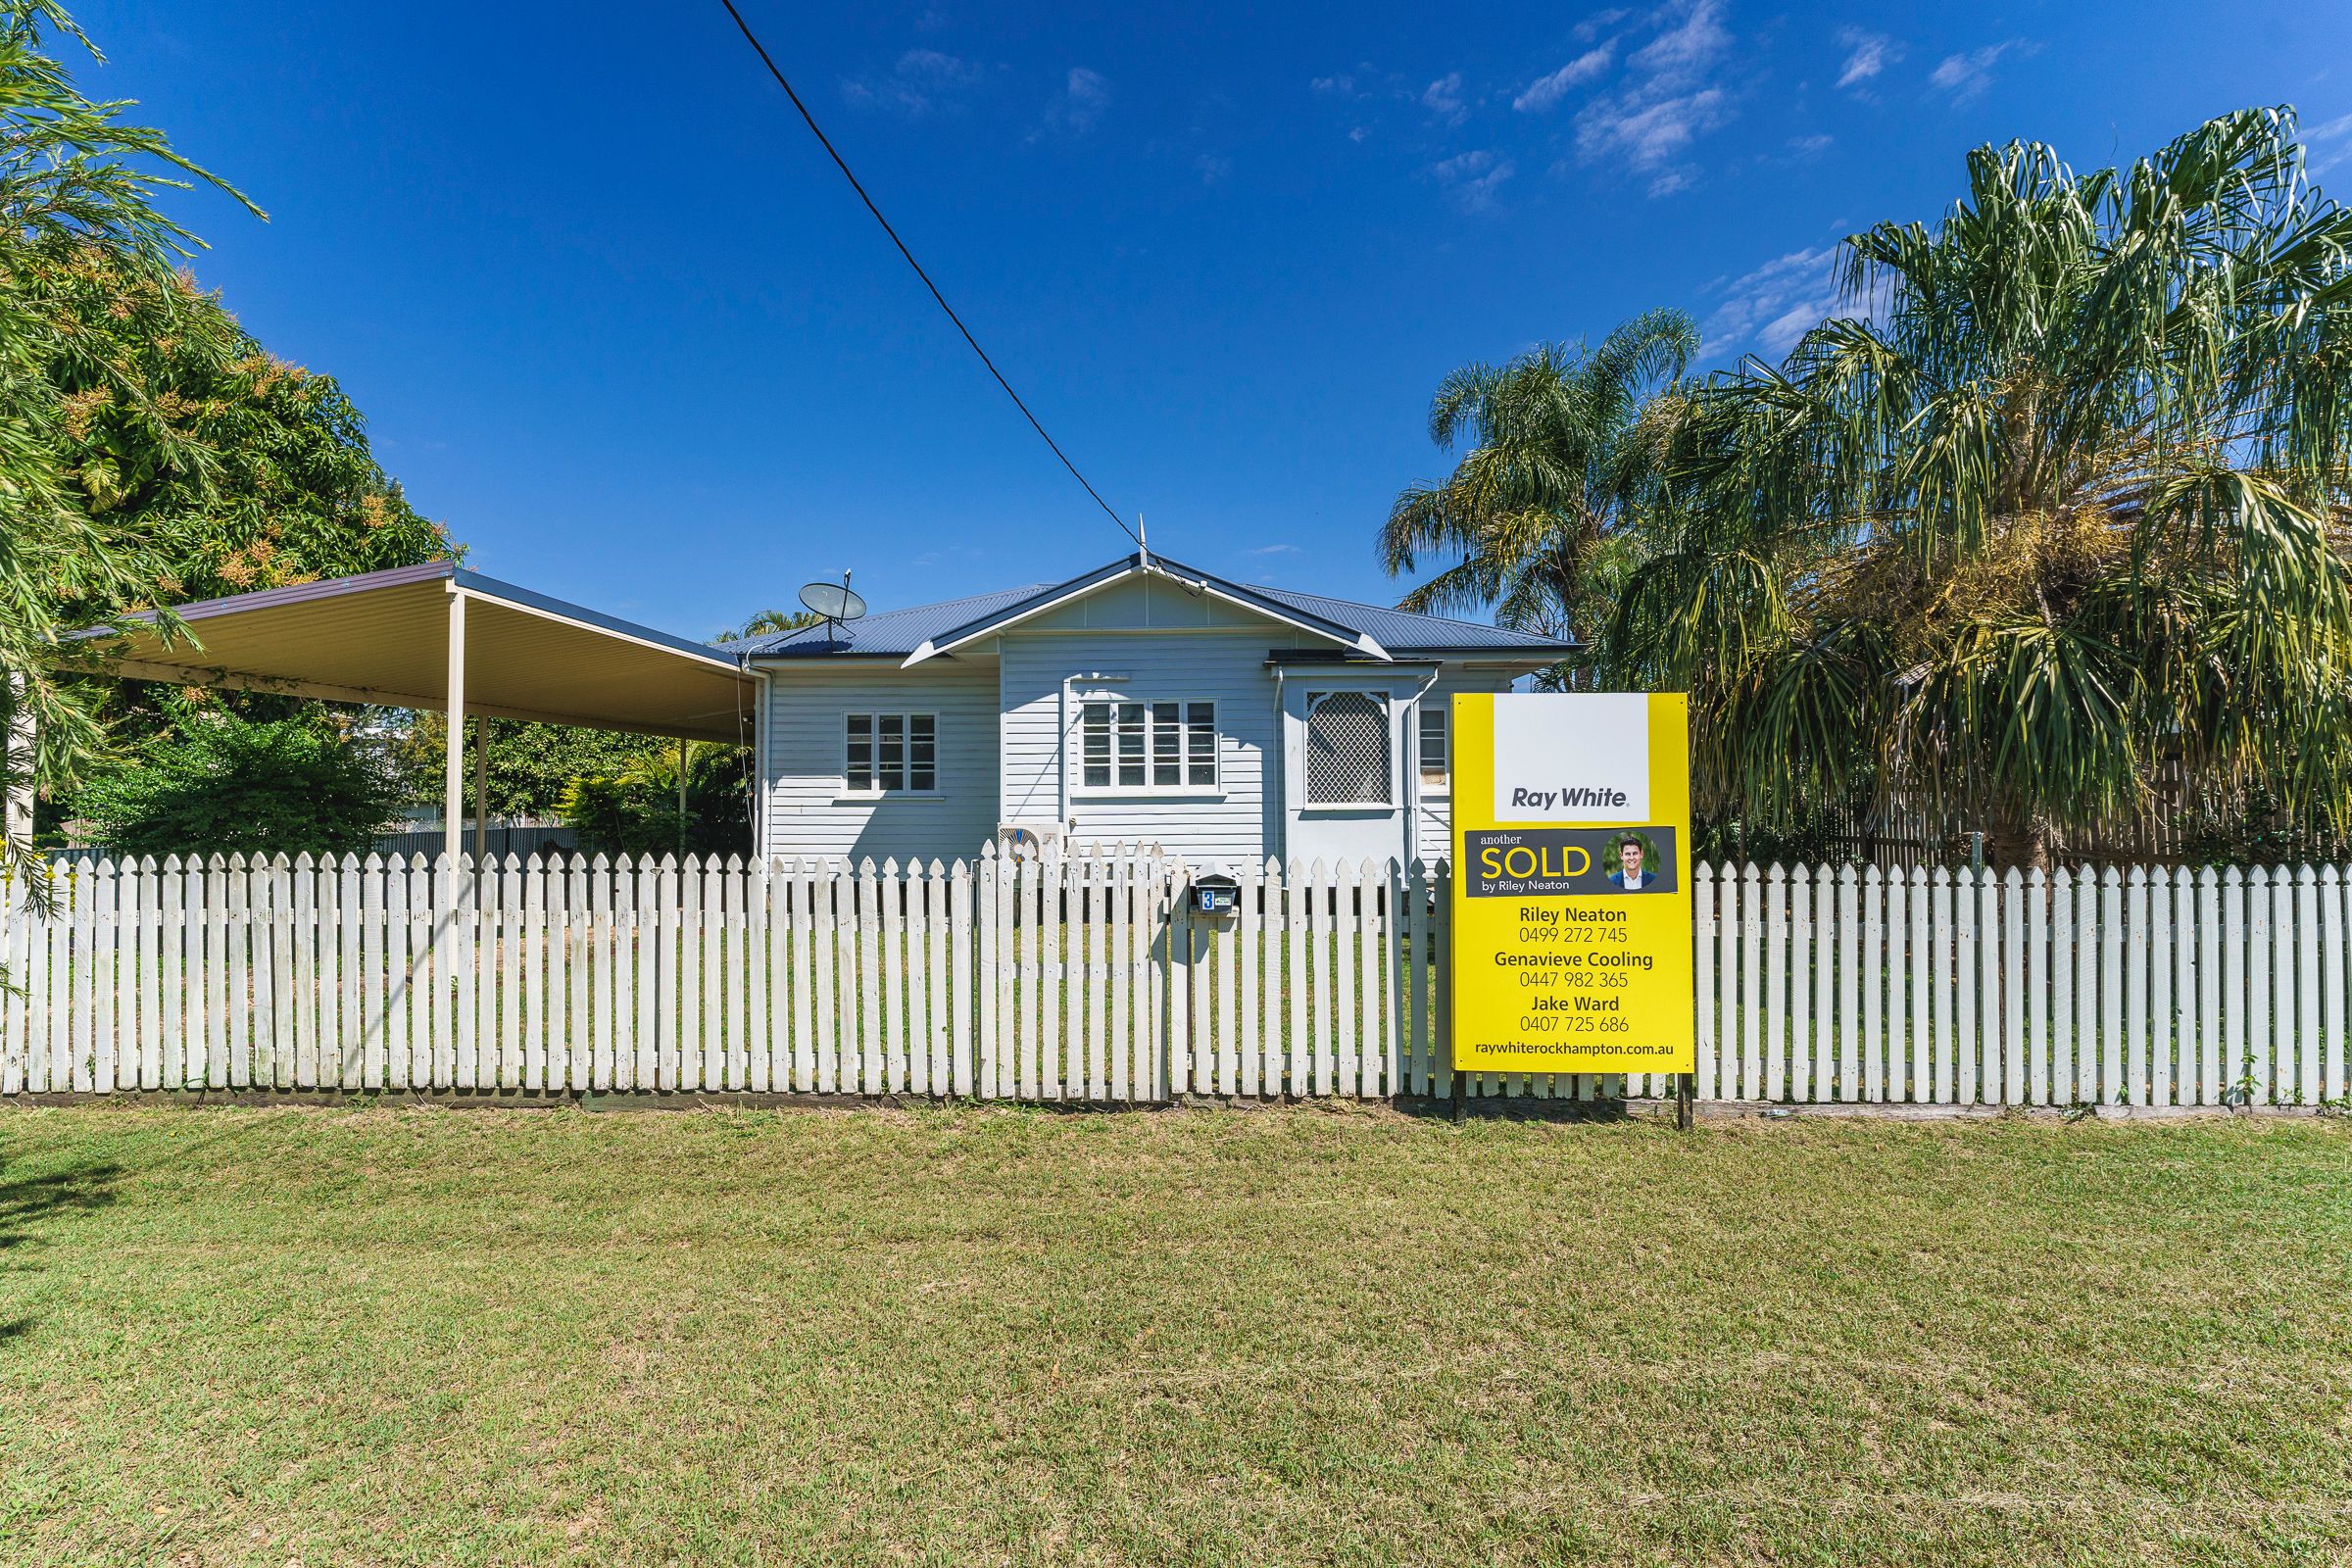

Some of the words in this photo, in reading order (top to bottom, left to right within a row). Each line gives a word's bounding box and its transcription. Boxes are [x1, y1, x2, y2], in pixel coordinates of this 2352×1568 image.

[1512, 788, 1557, 810] Ray
[1562, 788, 1626, 807] White
[1481, 834, 1522, 845] another
[1481, 846, 1592, 879] SOLD
[1482, 880, 1495, 892] by
[1498, 880, 1526, 893] Riley
[1528, 879, 1570, 890] Neaton
[1203, 893, 1213, 908] 3
[1521, 906, 1559, 925] Riley
[1566, 906, 1627, 922] Neaton
[1520, 927, 1558, 943] 0499
[1564, 927, 1593, 943] 272
[1598, 927, 1628, 943] 745
[1494, 952, 1582, 967] Genavieve
[1588, 951, 1653, 970] Cooling
[1520, 971, 1558, 987] 0447
[1564, 971, 1593, 988] 982
[1599, 971, 1629, 988] 365
[1531, 995, 1569, 1011] Jake
[1574, 996, 1620, 1011] Ward
[1520, 1015, 1559, 1032] 0407
[1565, 1016, 1594, 1032] 725
[1599, 1016, 1630, 1033] 686
[1475, 1041, 1674, 1057] raywhiterockhampton.com.au
